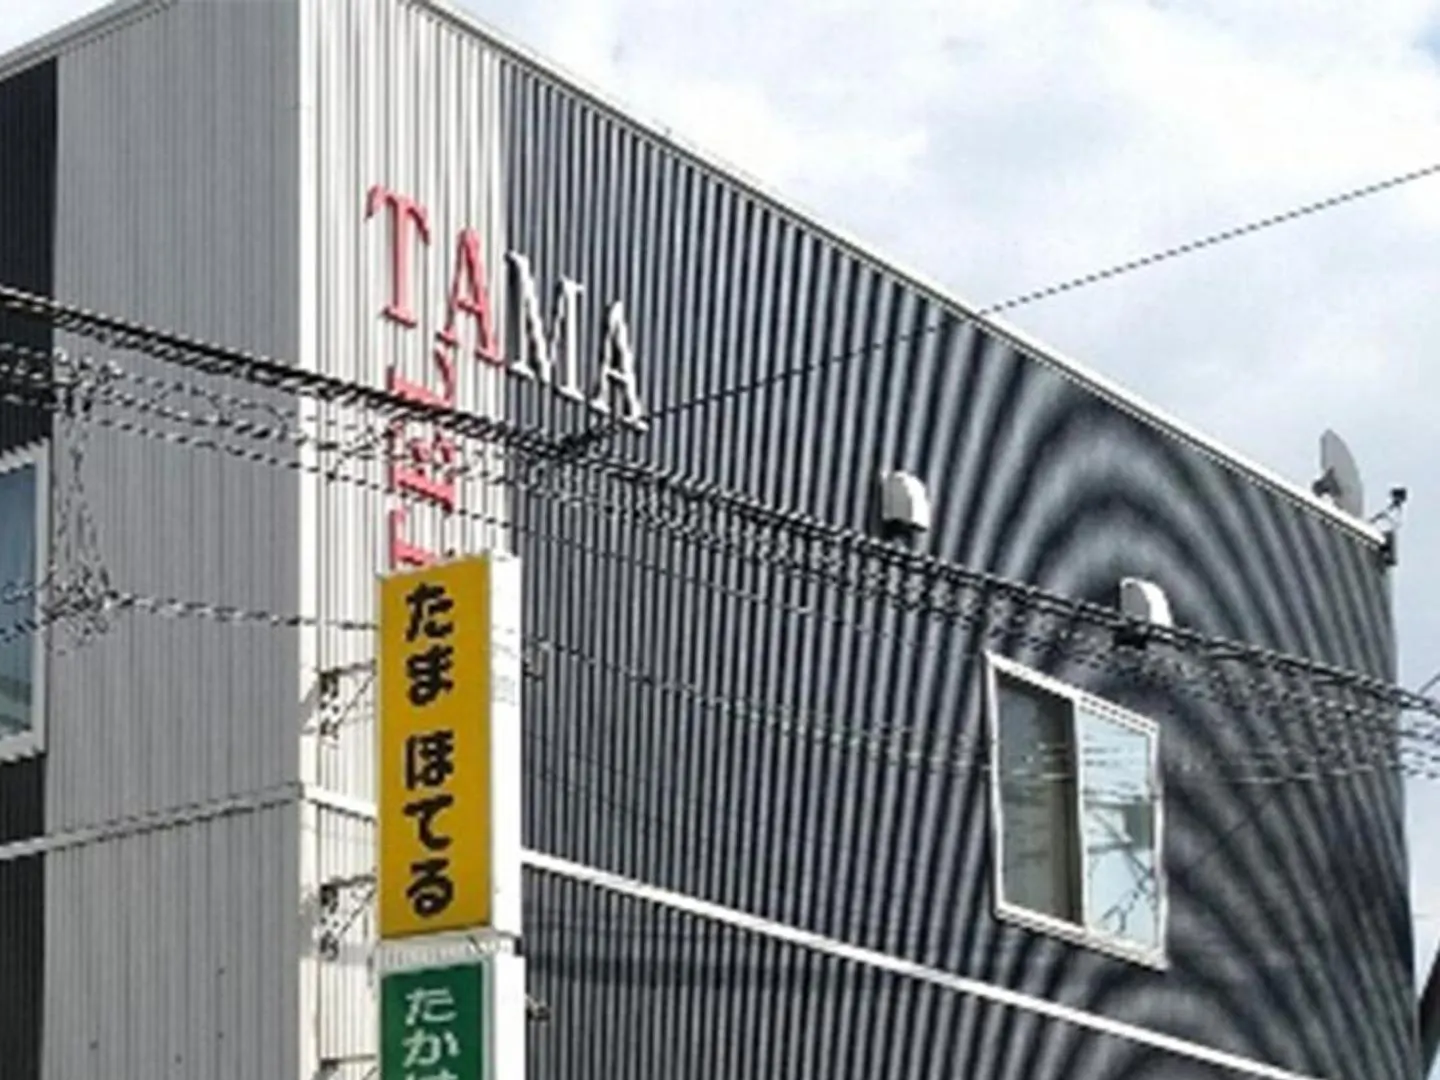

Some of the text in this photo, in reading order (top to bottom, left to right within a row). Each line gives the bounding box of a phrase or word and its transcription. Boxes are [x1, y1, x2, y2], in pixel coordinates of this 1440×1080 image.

[364, 183, 651, 433] TAMA
[401, 581, 456, 919] たま ほてる
